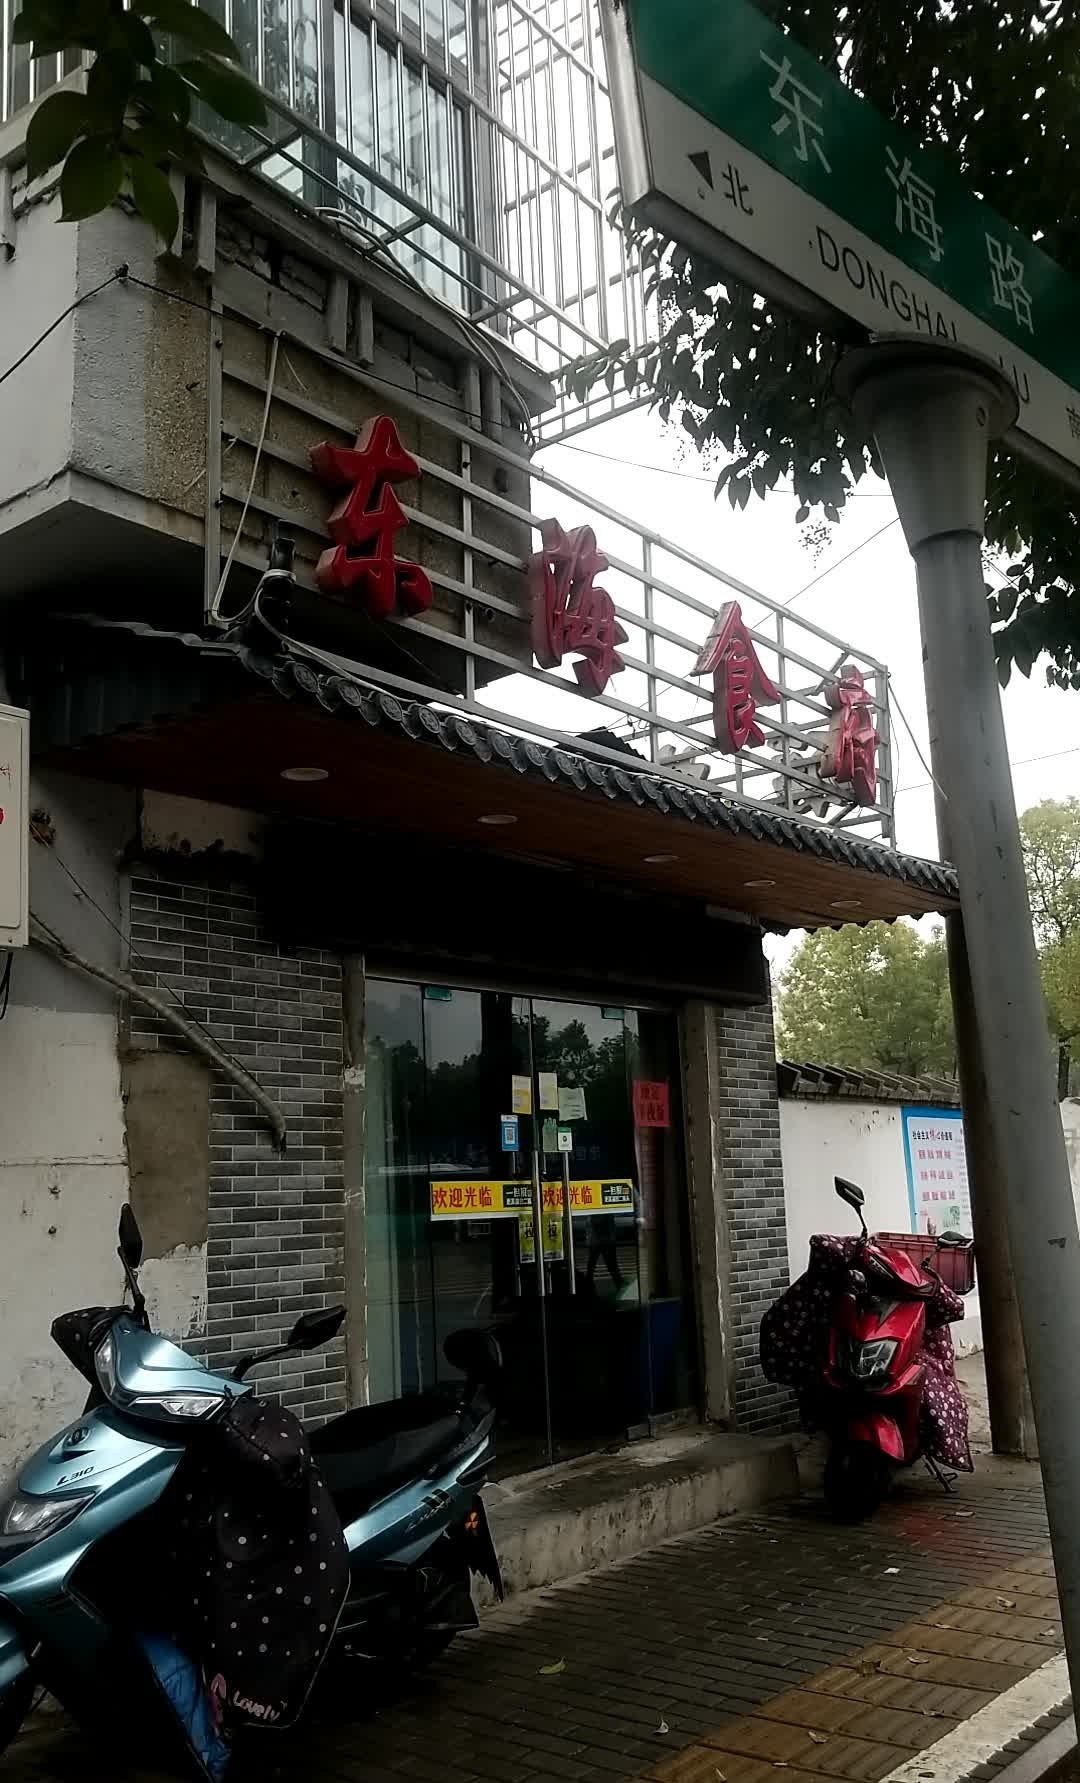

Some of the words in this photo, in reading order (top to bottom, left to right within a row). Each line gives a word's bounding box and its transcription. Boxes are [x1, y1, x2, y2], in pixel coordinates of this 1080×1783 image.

[722, 164, 754, 216] 北
[759, 49, 1034, 335] 东海路
[432, 1185, 492, 1209] 欢迎光临
[543, 1184, 593, 1207] 欢迎光临
